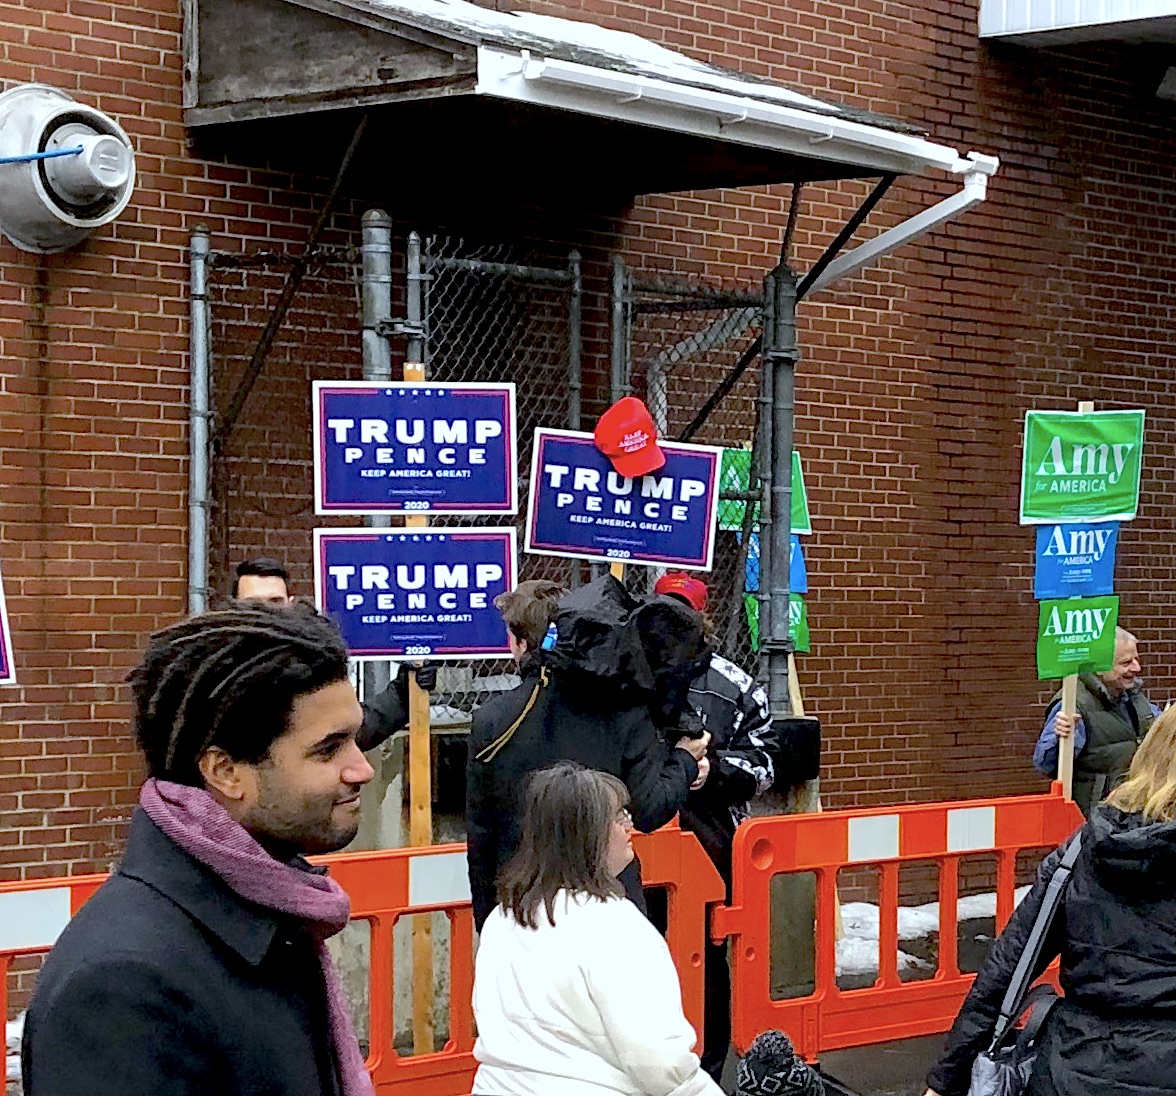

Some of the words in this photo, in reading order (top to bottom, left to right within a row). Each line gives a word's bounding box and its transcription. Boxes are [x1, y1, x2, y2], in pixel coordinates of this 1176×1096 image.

[328, 418, 502, 445] TRUMP
[345, 447, 487, 464] PENCE
[1035, 435, 1135, 485] Amy
[361, 469, 387, 478] KEEP
[389, 469, 434, 478] AMERICA
[435, 469, 472, 478] GREAT!
[544, 463, 706, 502] TRUMP
[1049, 479, 1107, 493] AMERICA
[404, 500, 431, 510] 2020
[556, 493, 689, 521] PENCE
[569, 514, 595, 524] KEEP
[595, 518, 638, 529] AMERICA
[638, 522, 673, 533] GREAT!
[1042, 525, 1114, 562] Amy
[606, 548, 631, 559] 2020
[329, 564, 503, 590] TRUMP
[346, 592, 488, 610] PENCE
[362, 615, 388, 623] KEEP
[390, 614, 435, 623] AMERICA
[436, 614, 472, 623] GREAT!
[1042, 605, 1113, 640] Amy
[405, 646, 432, 655] 2020
